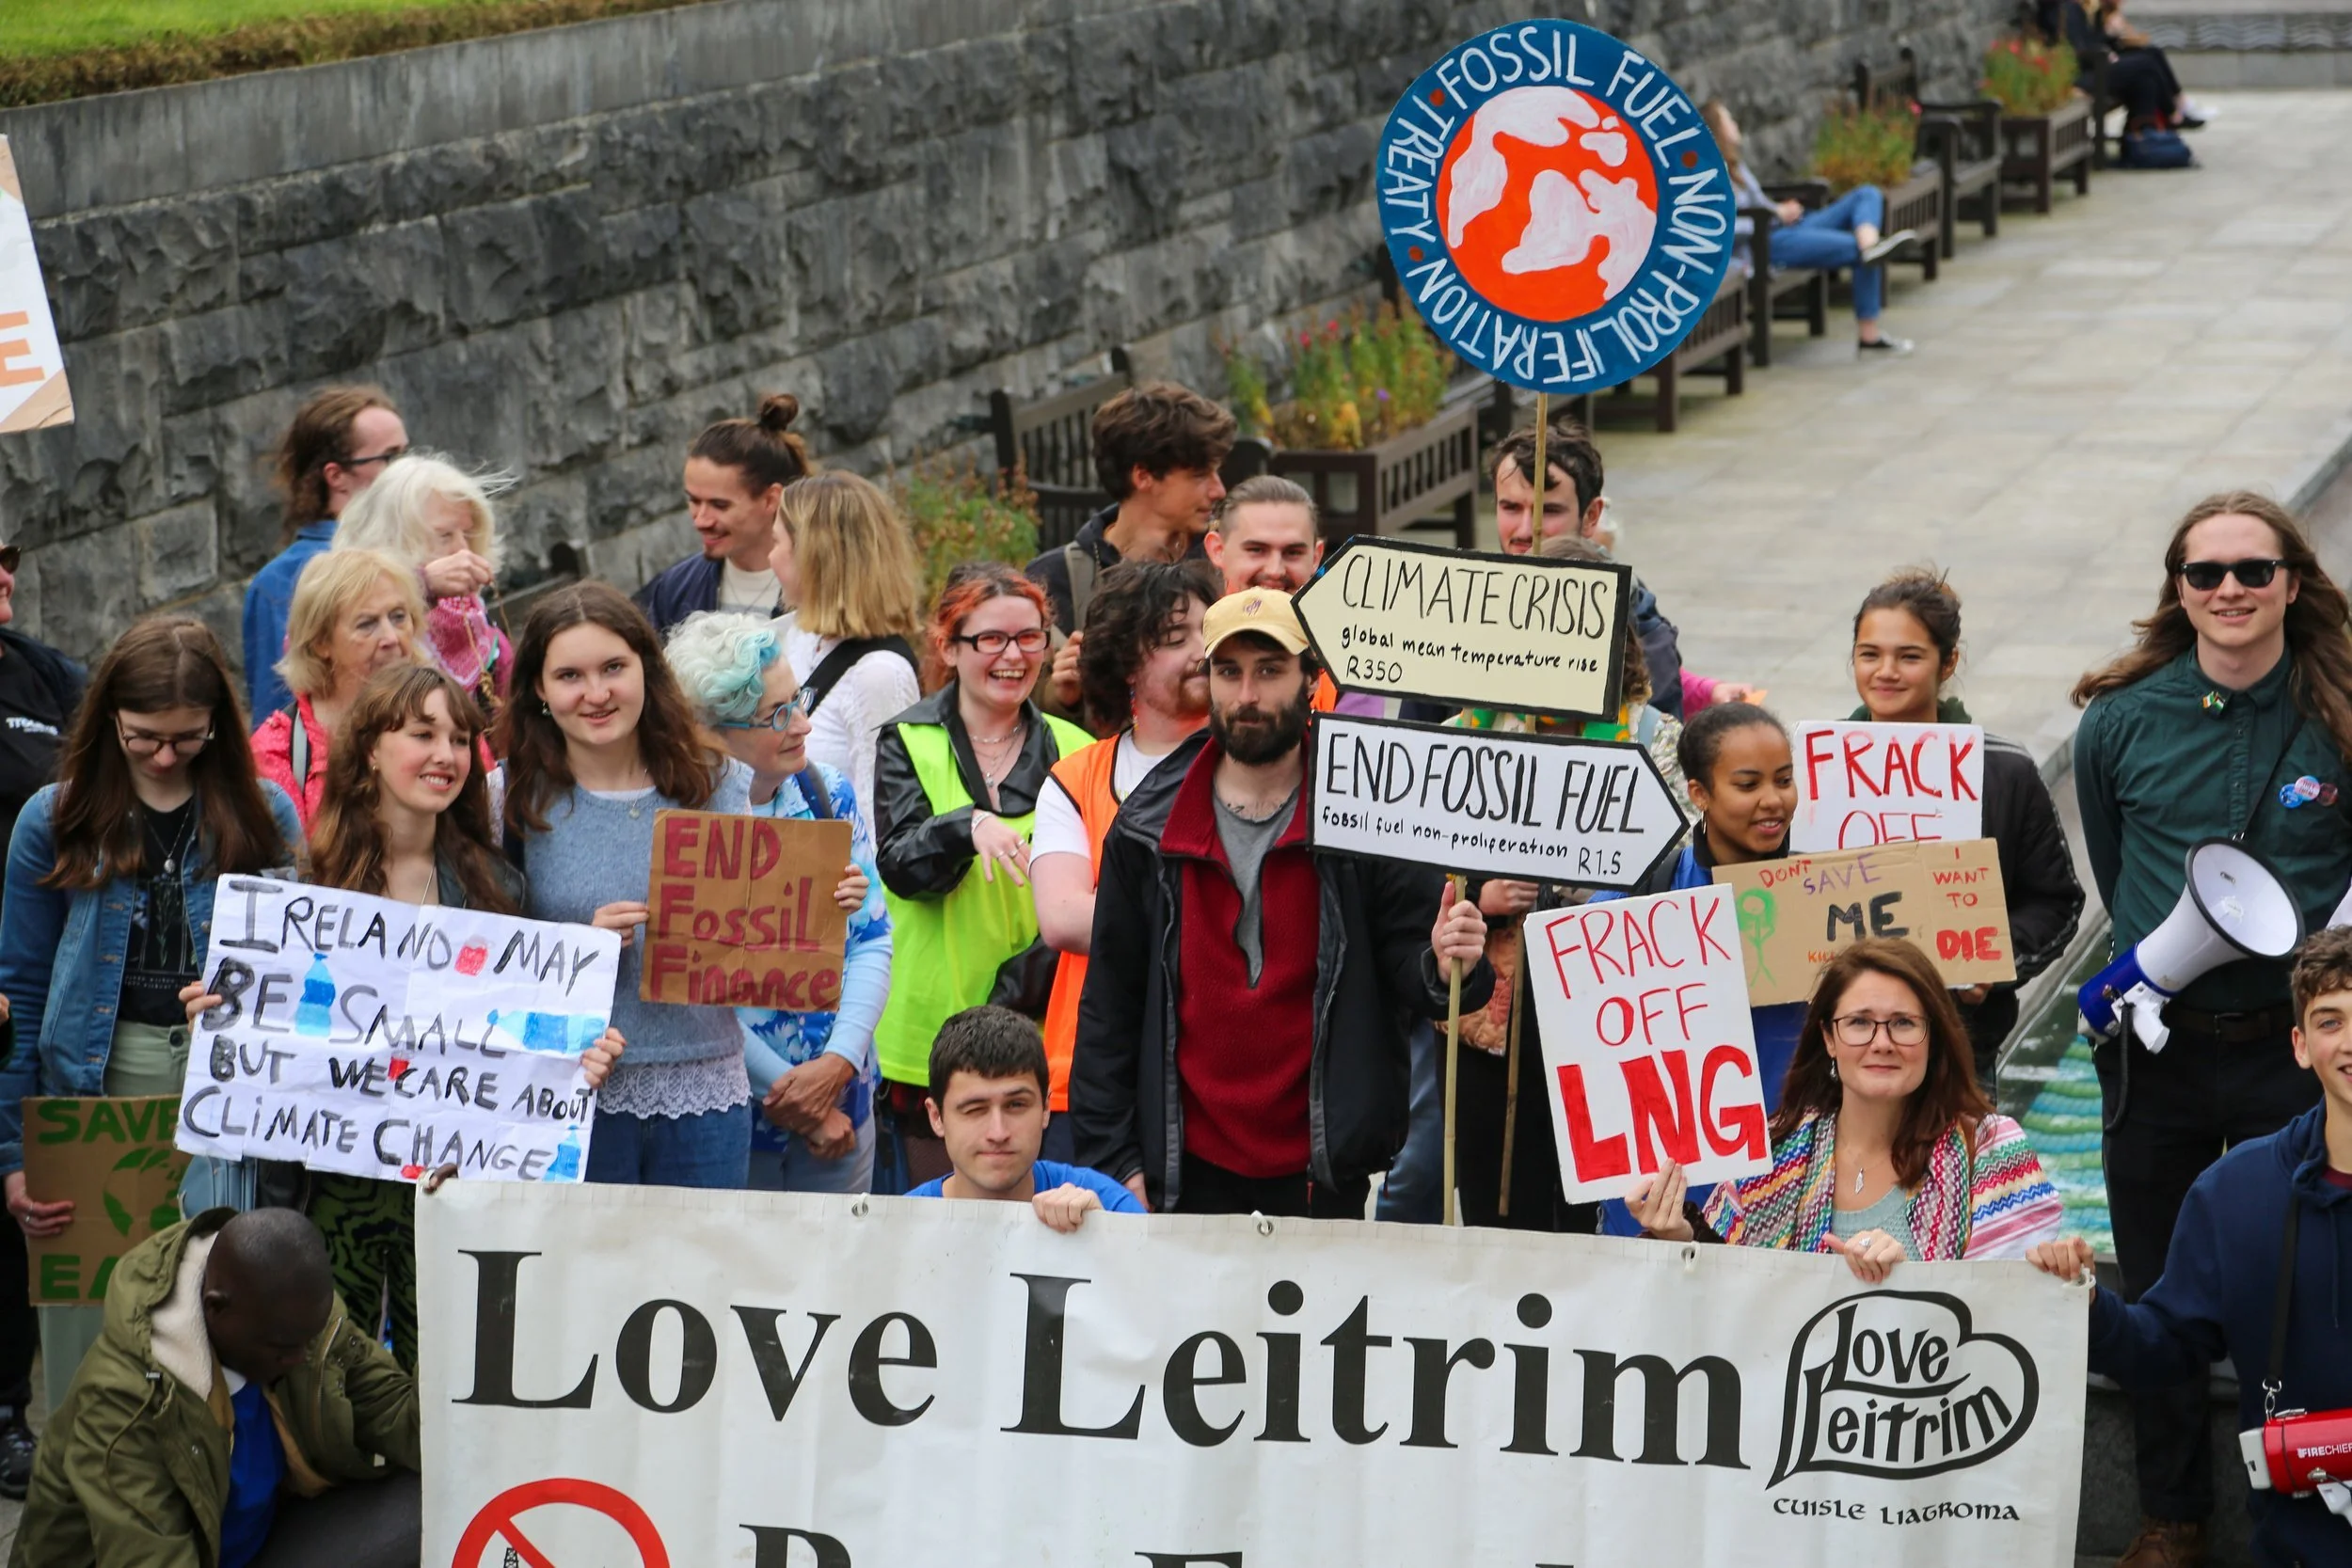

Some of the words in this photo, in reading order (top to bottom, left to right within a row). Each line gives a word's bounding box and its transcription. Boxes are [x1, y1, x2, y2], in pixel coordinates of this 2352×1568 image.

[1436, 25, 1596, 111] FOSSIL
[1605, 50, 1702, 169] FUEL
[1383, 93, 1455, 244] TREATY
[1406, 167, 1727, 386] NON-PROLIFERATION
[1343, 554, 1504, 626] CLIMATE
[1509, 574, 1608, 640] CRISIS
[1342, 624, 1394, 649] global
[1402, 640, 1446, 658] mean
[1450, 642, 1562, 674] temperature
[1568, 657, 1598, 673] rise
[1345, 656, 1403, 684] R350
[1326, 733, 1415, 804] END
[1420, 744, 1542, 828] FOSSIL
[1555, 760, 1645, 835] FUEL
[1805, 729, 1979, 801] FRACK
[663, 816, 782, 881] END
[1322, 805, 1369, 832] fossil
[1375, 816, 1405, 837] fuel
[1412, 822, 1568, 858] non-proliferation
[1578, 847, 1622, 877] R1.5
[1804, 852, 1882, 895] SAVE
[1931, 867, 1990, 886] WANT
[1954, 847, 1961, 860] I
[218, 879, 453, 971] IRELAND
[492, 929, 600, 997] MAY
[1826, 891, 1911, 942] ME
[1946, 893, 1979, 909] TO
[649, 942, 839, 1010] Finance
[1545, 895, 1732, 1001] FRACK
[1935, 927, 2004, 962] DIE
[200, 956, 294, 1033] BE
[328, 984, 507, 1059] SMALL
[1596, 982, 1708, 1047] OFF
[209, 1034, 296, 1085] BUT
[327, 1056, 388, 1098] WE
[392, 1066, 500, 1112] CARE
[512, 1085, 594, 1124] ABOUT
[1556, 1044, 1768, 1184] LNG
[373, 1118, 554, 1181] CHANGE
[451, 1248, 939, 1428] Love
[999, 1271, 1752, 1470] Leitrim
[1820, 1302, 1971, 1400] Love
[1785, 1362, 2013, 1479] Leitrim
